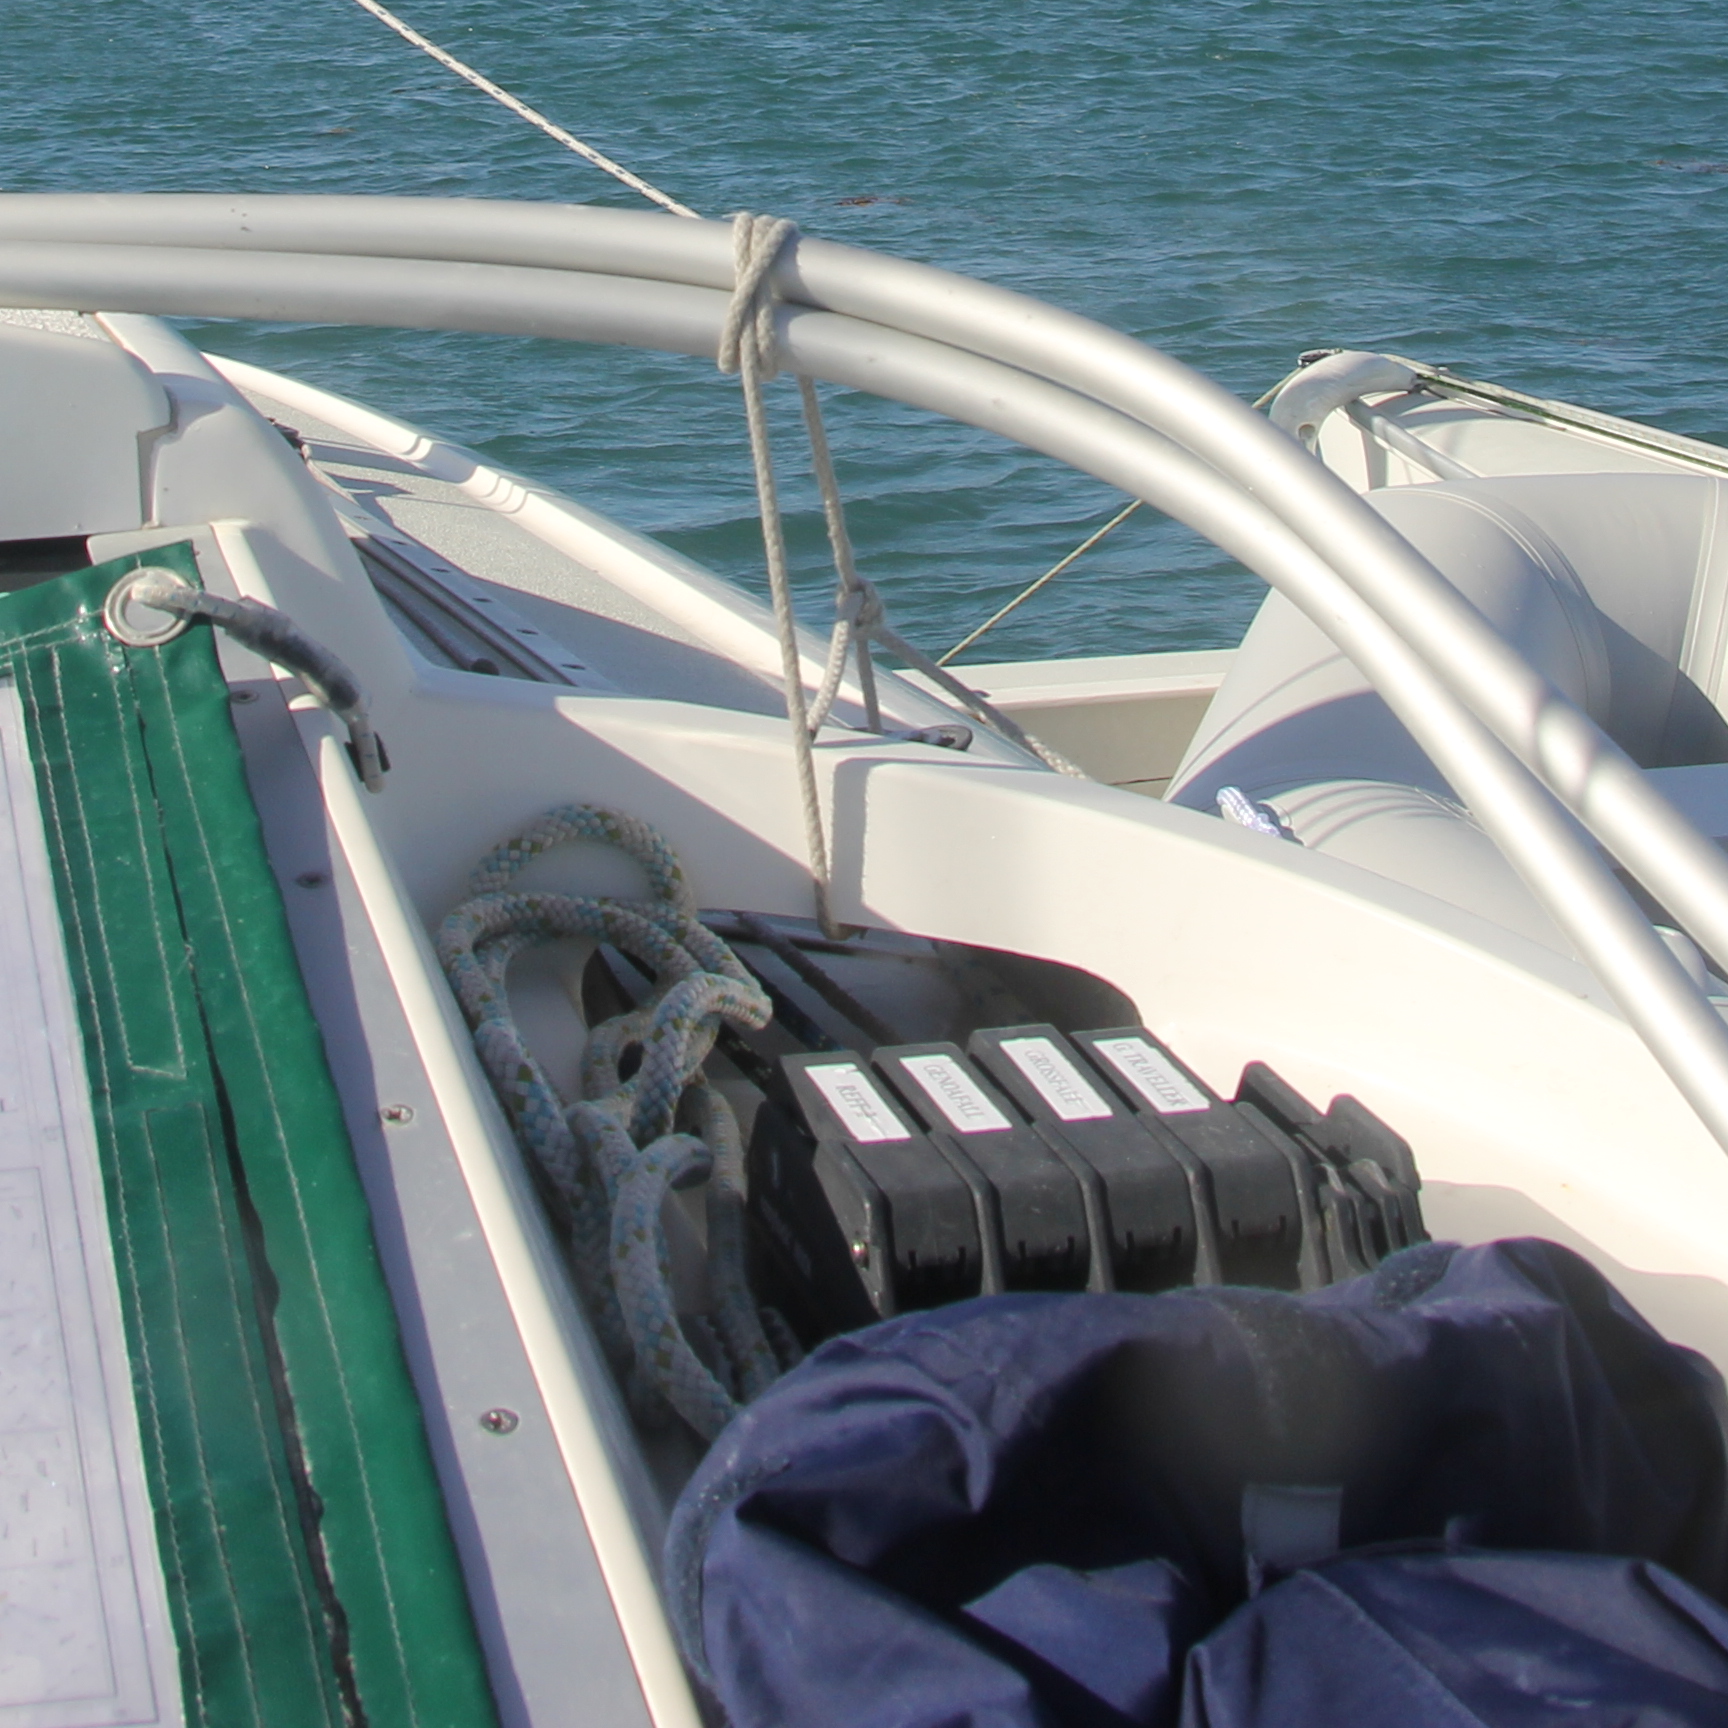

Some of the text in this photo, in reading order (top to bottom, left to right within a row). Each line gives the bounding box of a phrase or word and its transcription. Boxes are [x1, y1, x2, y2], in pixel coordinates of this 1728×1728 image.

[923, 1063, 985, 1119] GENOAFALL
[1113, 1042, 1188, 1108] G TRAVELLER
